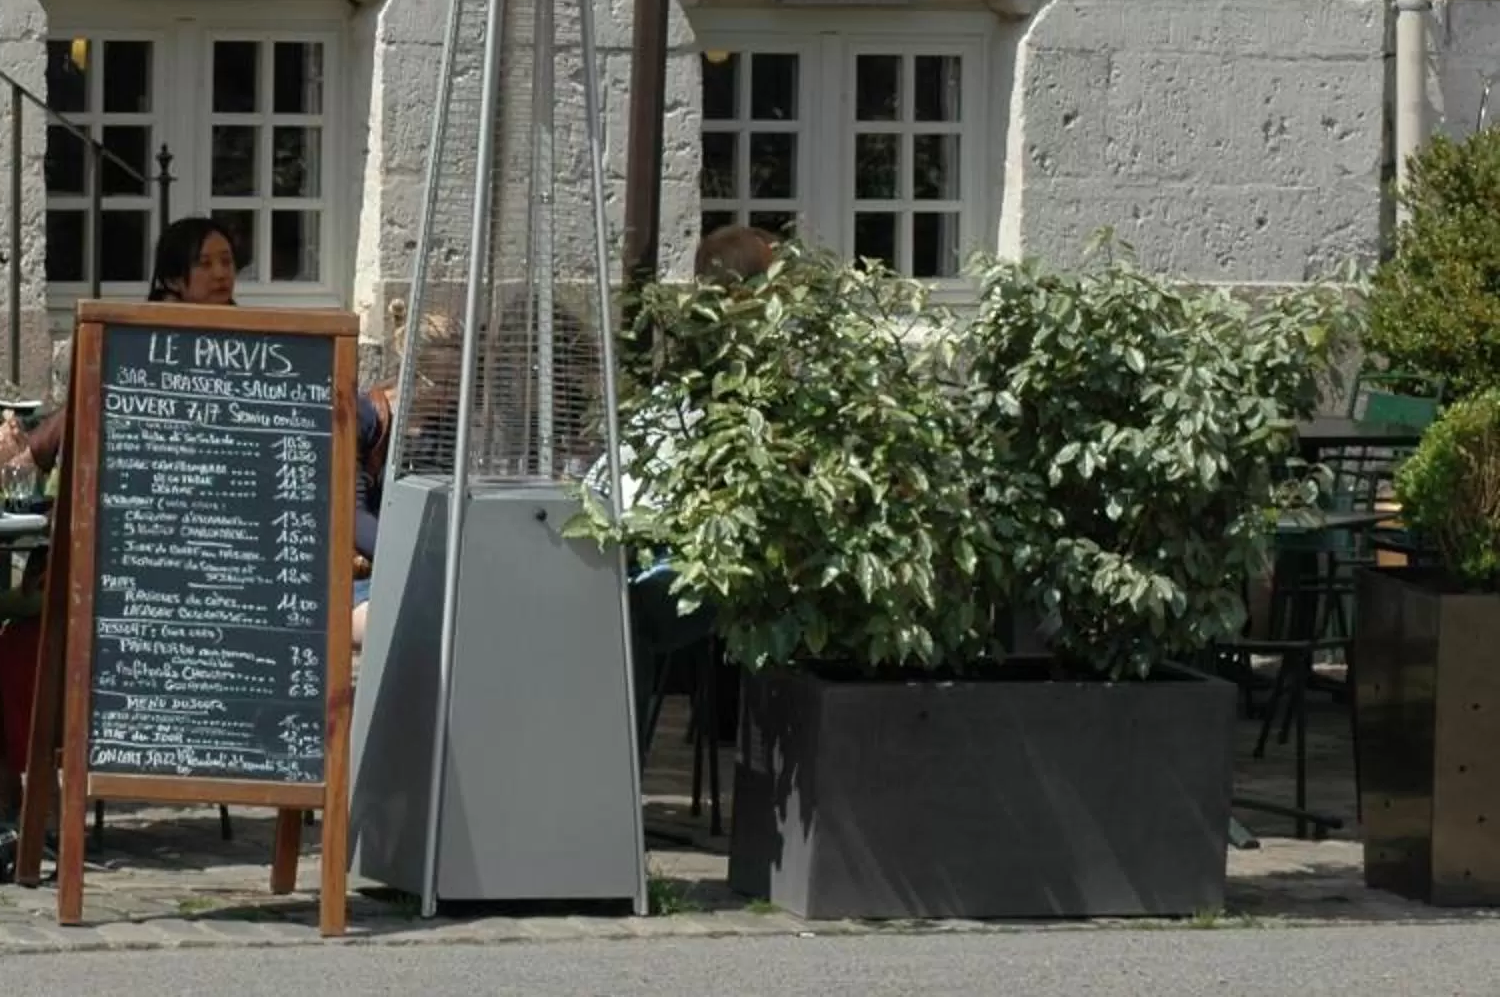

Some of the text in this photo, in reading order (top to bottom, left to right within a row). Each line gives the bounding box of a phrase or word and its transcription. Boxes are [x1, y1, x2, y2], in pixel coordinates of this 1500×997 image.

[149, 331, 294, 374] LE PARVIS
[105, 393, 178, 416] OUVERT
